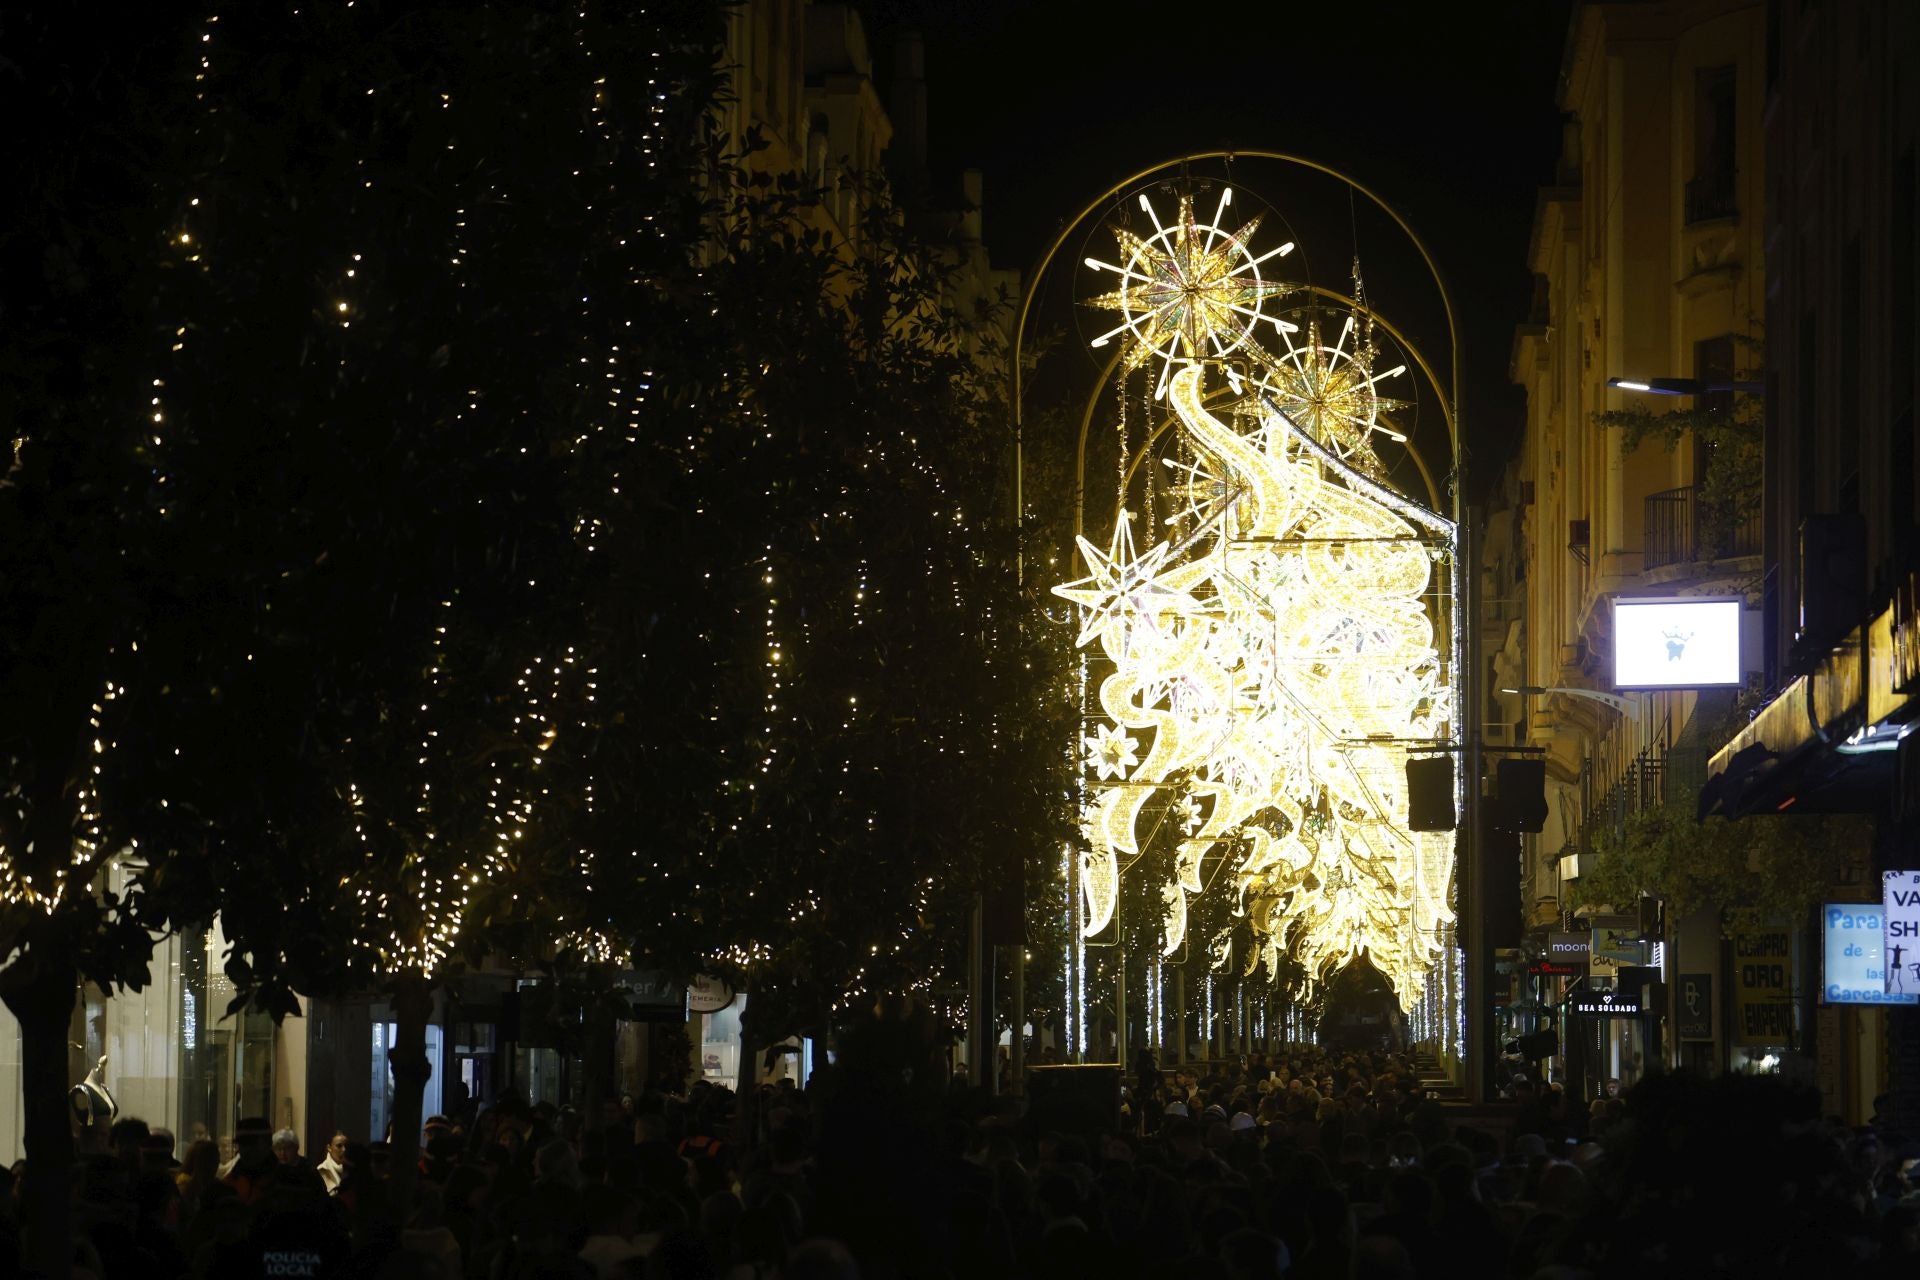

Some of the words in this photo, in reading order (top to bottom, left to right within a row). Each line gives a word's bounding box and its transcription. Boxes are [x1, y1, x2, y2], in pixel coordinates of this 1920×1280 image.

[1828, 909, 1884, 929] Para
[1552, 943, 1591, 952] moon
[1844, 943, 1862, 957] de
[1743, 965, 1784, 988] ORO
[1578, 1004, 1595, 1012] BEA
[1598, 1004, 1637, 1012] SOLDADO
[267, 1264, 315, 1277] LOCAL
